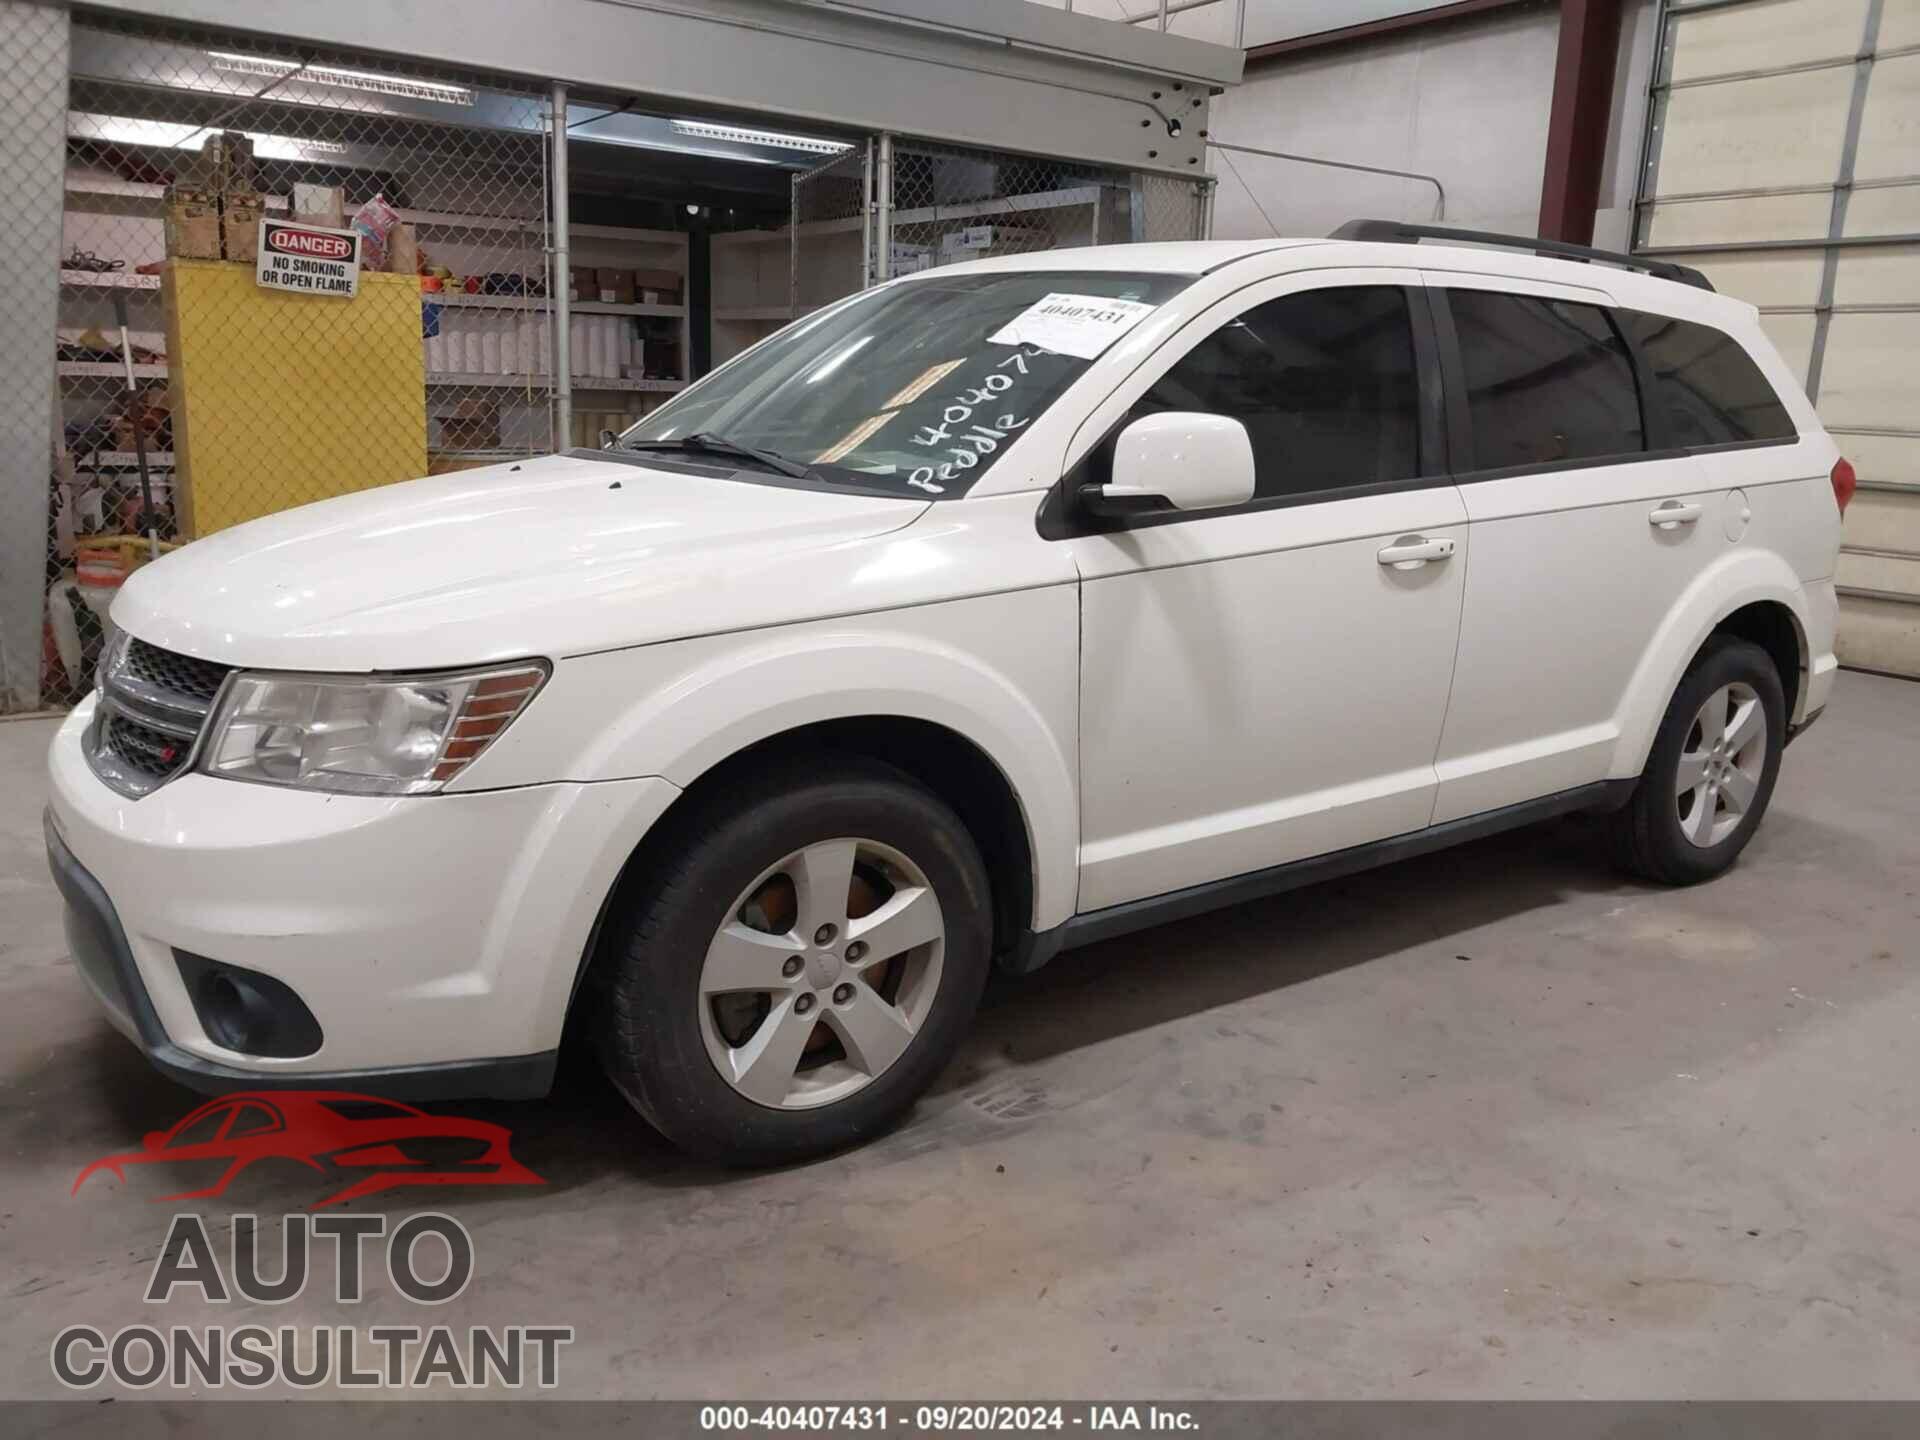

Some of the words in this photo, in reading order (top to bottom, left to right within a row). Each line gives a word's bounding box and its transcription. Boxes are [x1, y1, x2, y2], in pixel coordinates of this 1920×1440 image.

[275, 232, 347, 255] DANGER
[272, 256, 289, 270] NO
[292, 259, 345, 277] SMOKING
[262, 270, 278, 283] OR
[281, 272, 312, 287] OPEN
[315, 277, 352, 293] FLAME
[1040, 304, 1125, 324] 40407431
